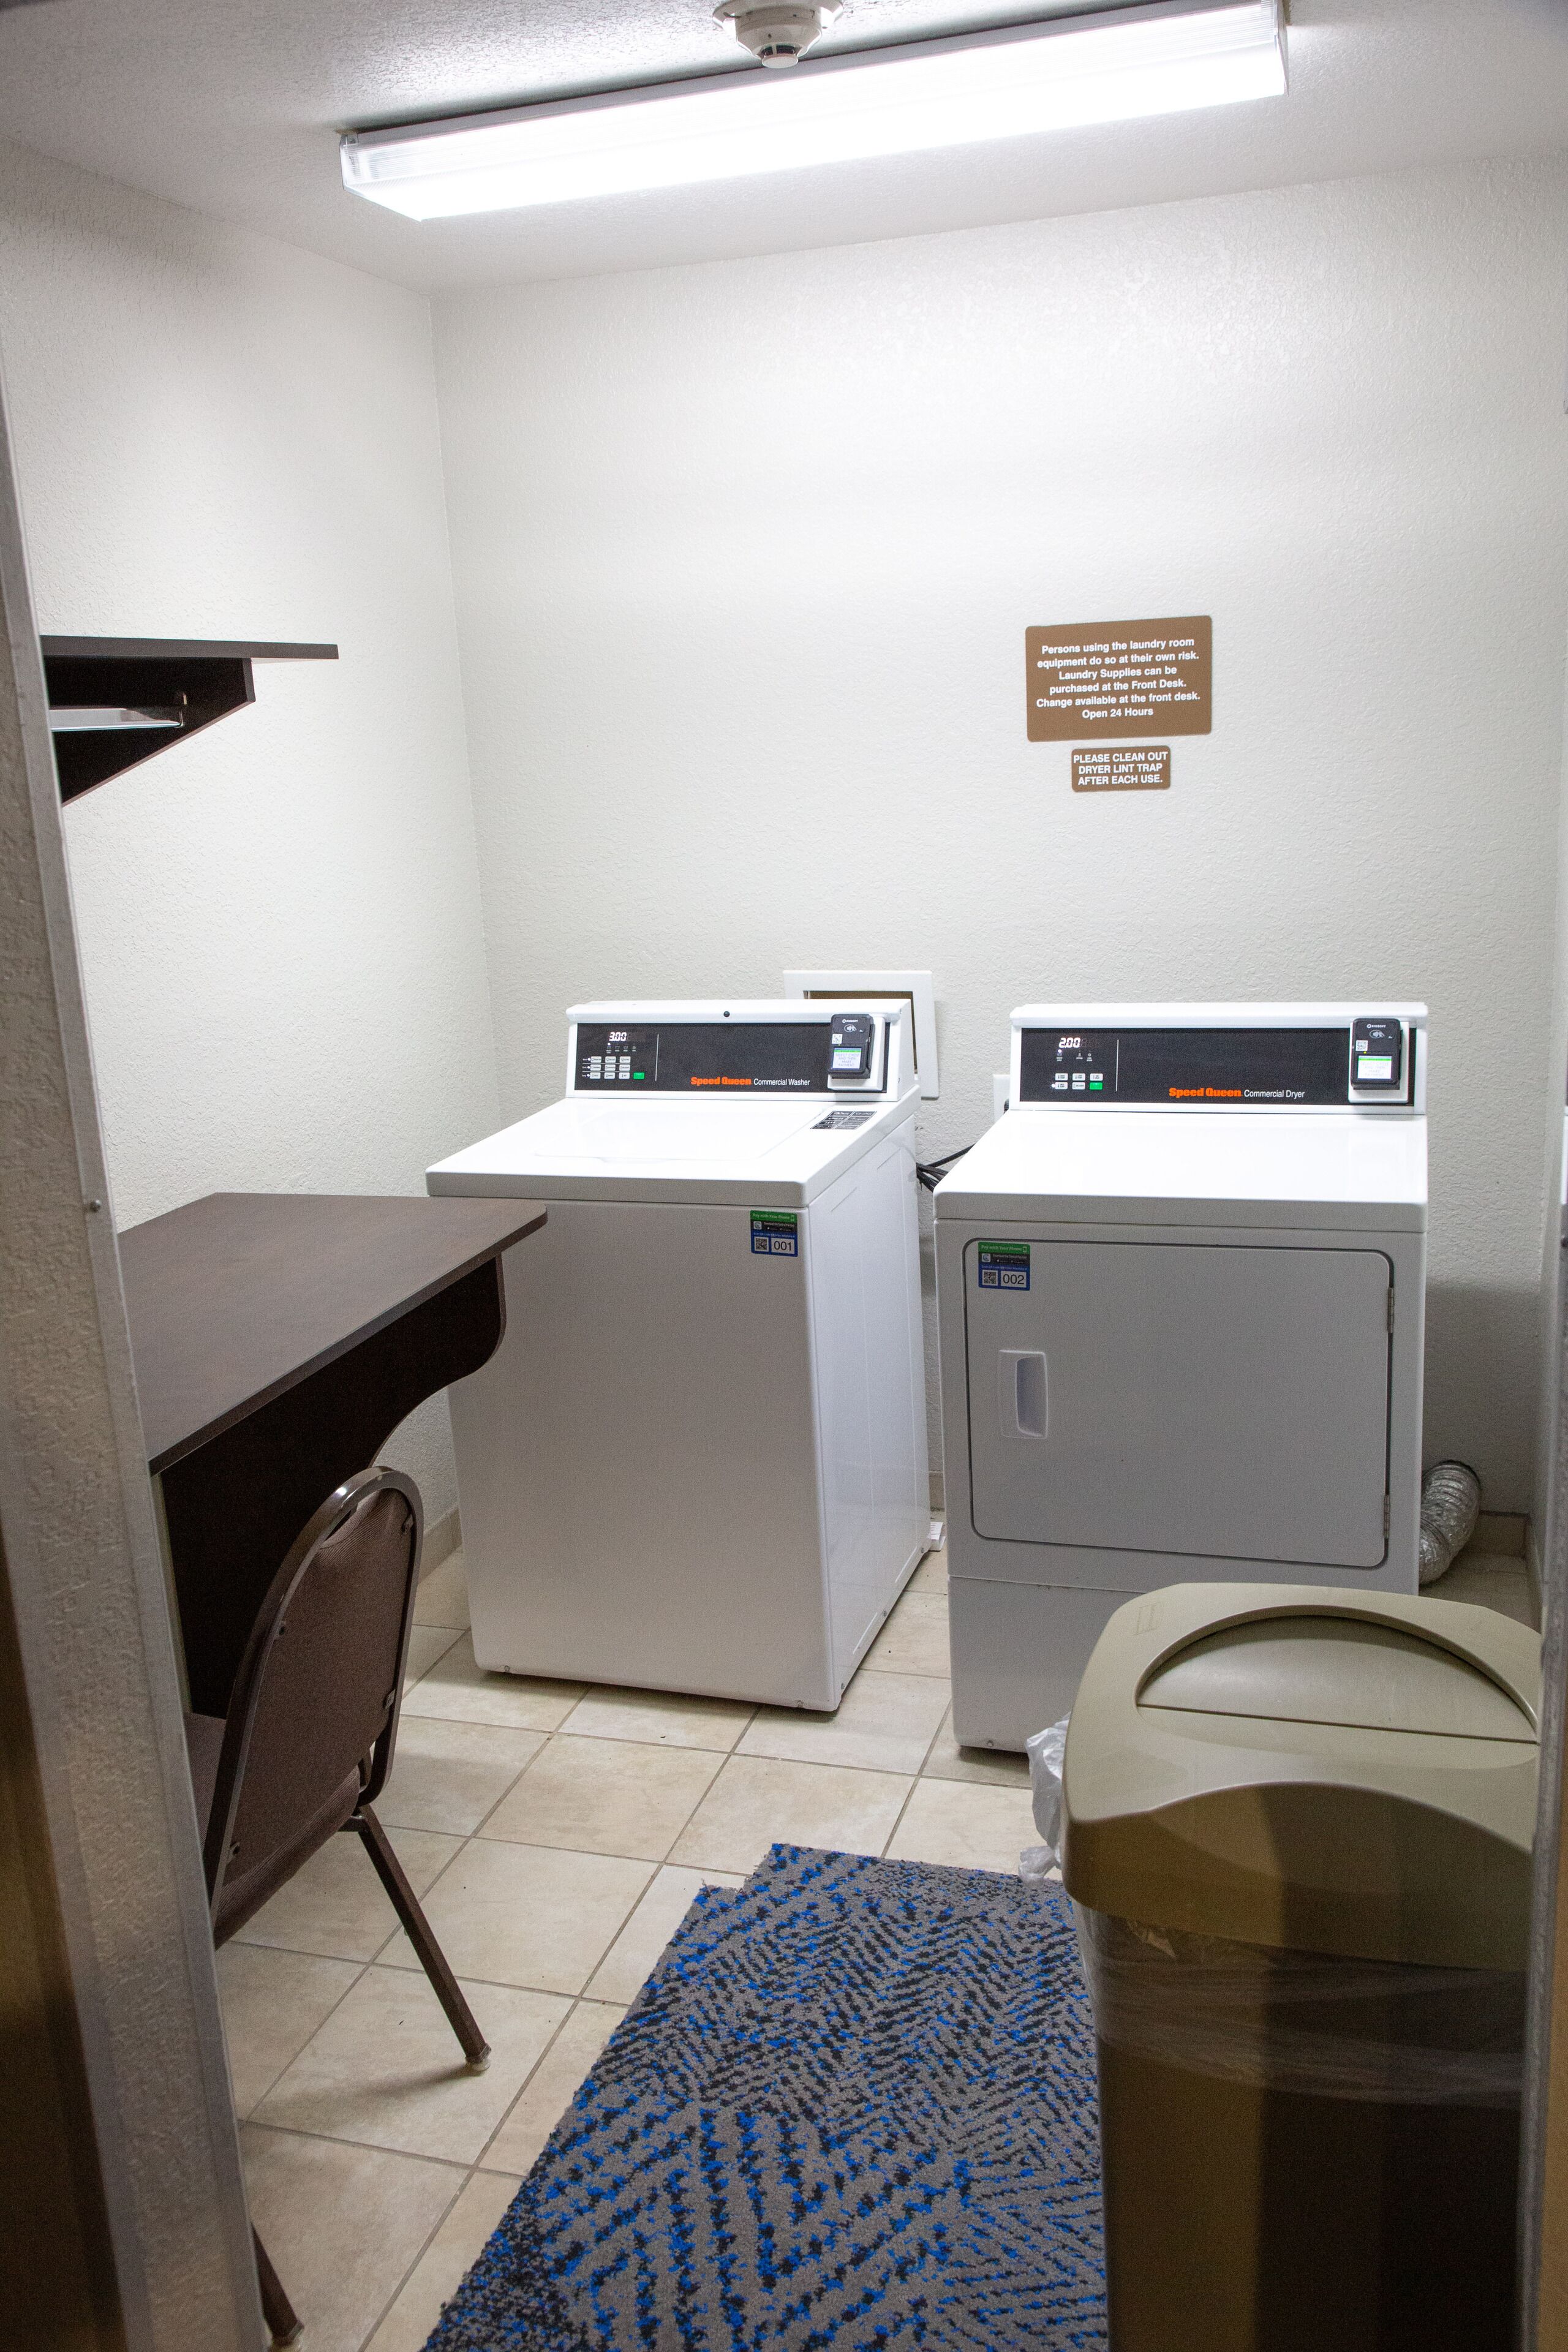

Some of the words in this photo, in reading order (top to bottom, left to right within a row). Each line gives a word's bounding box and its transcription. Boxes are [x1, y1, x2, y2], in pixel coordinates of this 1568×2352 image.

[1084, 643, 1109, 652] using
[1130, 639, 1166, 649] laundry
[1038, 658, 1087, 669] equipment
[1131, 654, 1152, 662] their
[1178, 651, 1199, 660] risk.
[1059, 670, 1097, 680] Laundry
[1101, 668, 1141, 679] Supplies
[1050, 683, 1099, 695] purchased
[1132, 680, 1156, 689] Front
[1160, 679, 1186, 688] Desk.
[1037, 699, 1072, 708] Change
[1076, 696, 1116, 705] available
[1174, 692, 1200, 700] desk.
[1082, 710, 1107, 720] Open
[1074, 754, 1109, 763] PLEASE
[1113, 753, 1144, 762] CLEAN
[1079, 765, 1110, 774] DRYER
[1114, 764, 1134, 773] LINT
[1137, 763, 1162, 772] TRAP
[1078, 776, 1109, 785] AFTER
[1112, 775, 1137, 784] EACH
[1141, 774, 1163, 783] USE.
[1059, 1038, 1080, 1048] 2.00
[690, 1077, 720, 1086] Speed
[1169, 1087, 1204, 1098] Speed
[1205, 1088, 1242, 1096] Queen
[1286, 1090, 1305, 1099] Dryer
[774, 1241, 791, 1251] 001
[1003, 1274, 1024, 1284] 002
